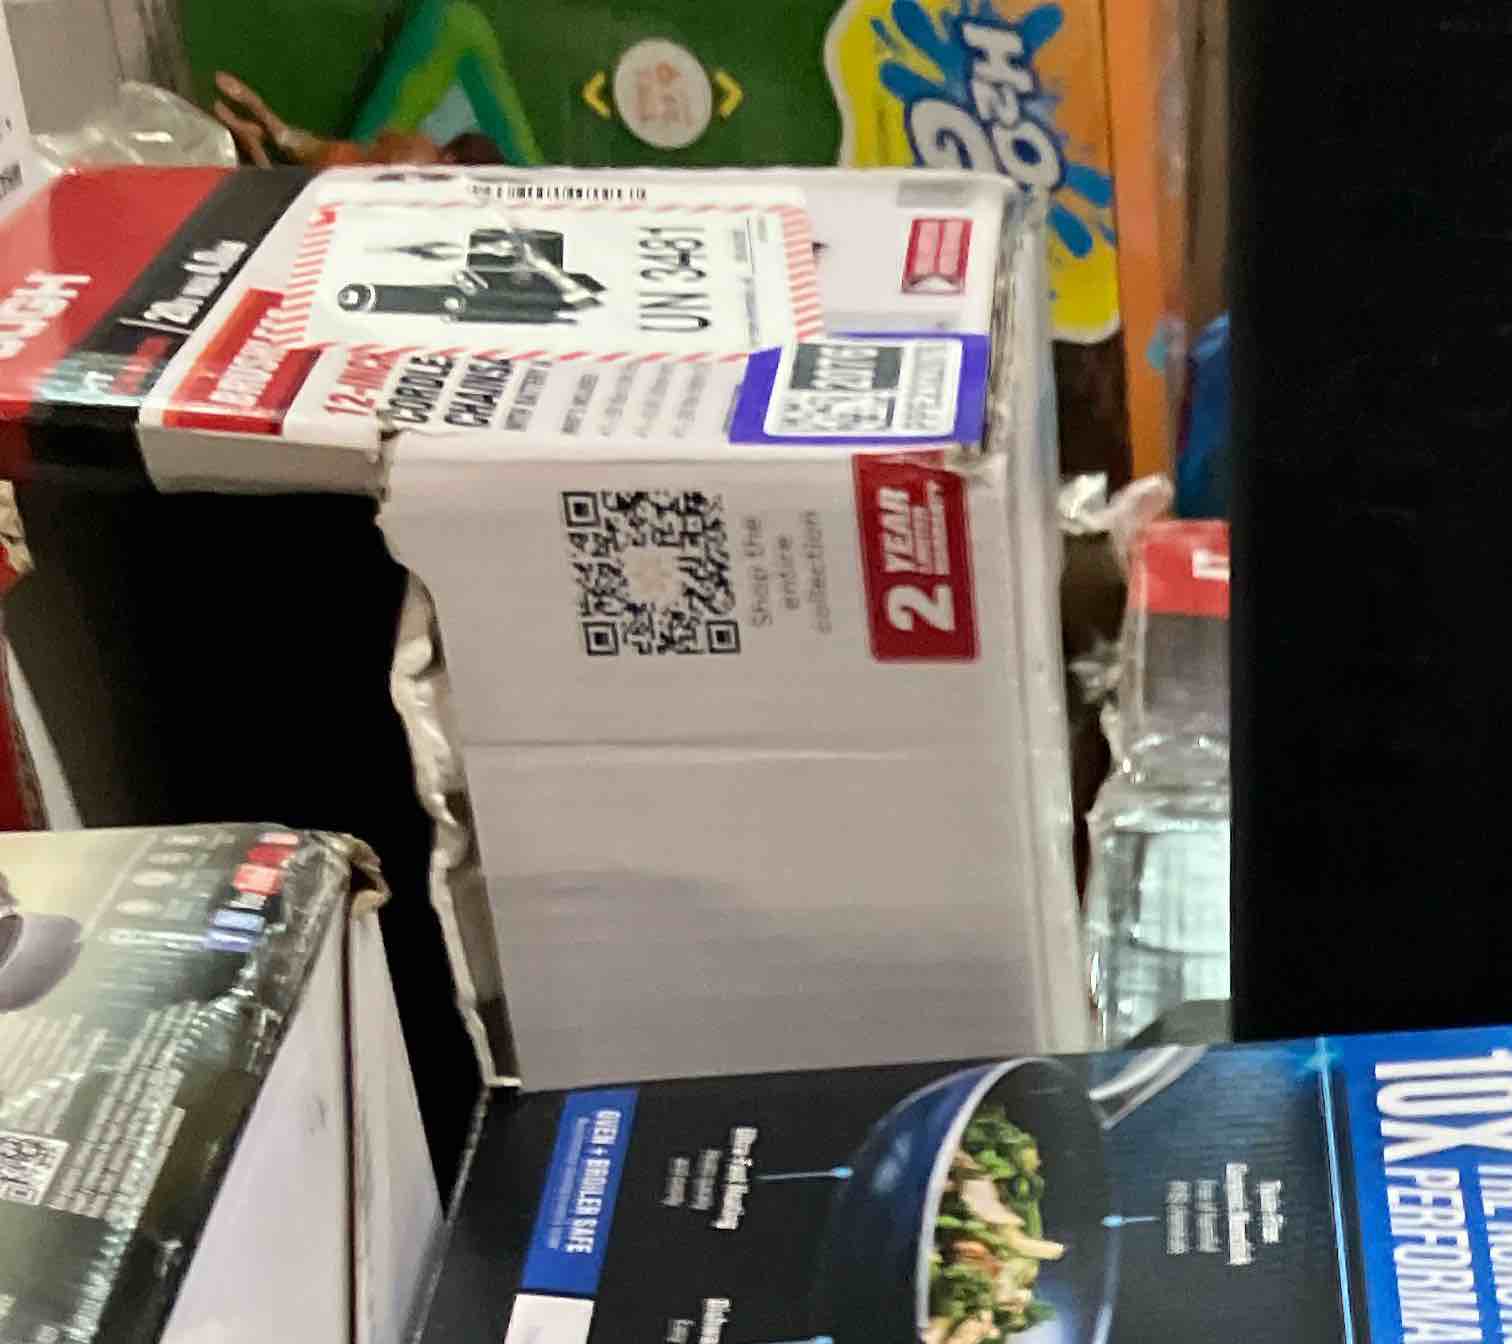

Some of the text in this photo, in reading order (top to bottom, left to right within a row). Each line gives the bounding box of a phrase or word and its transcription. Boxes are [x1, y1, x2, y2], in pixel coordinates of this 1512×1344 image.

[382, 352, 456, 426] CORDLE
[883, 585, 956, 632] 2
[592, 1110, 621, 1144] OVEN
[573, 1158, 611, 1215] BROILER
[564, 1218, 599, 1254] SAFE
